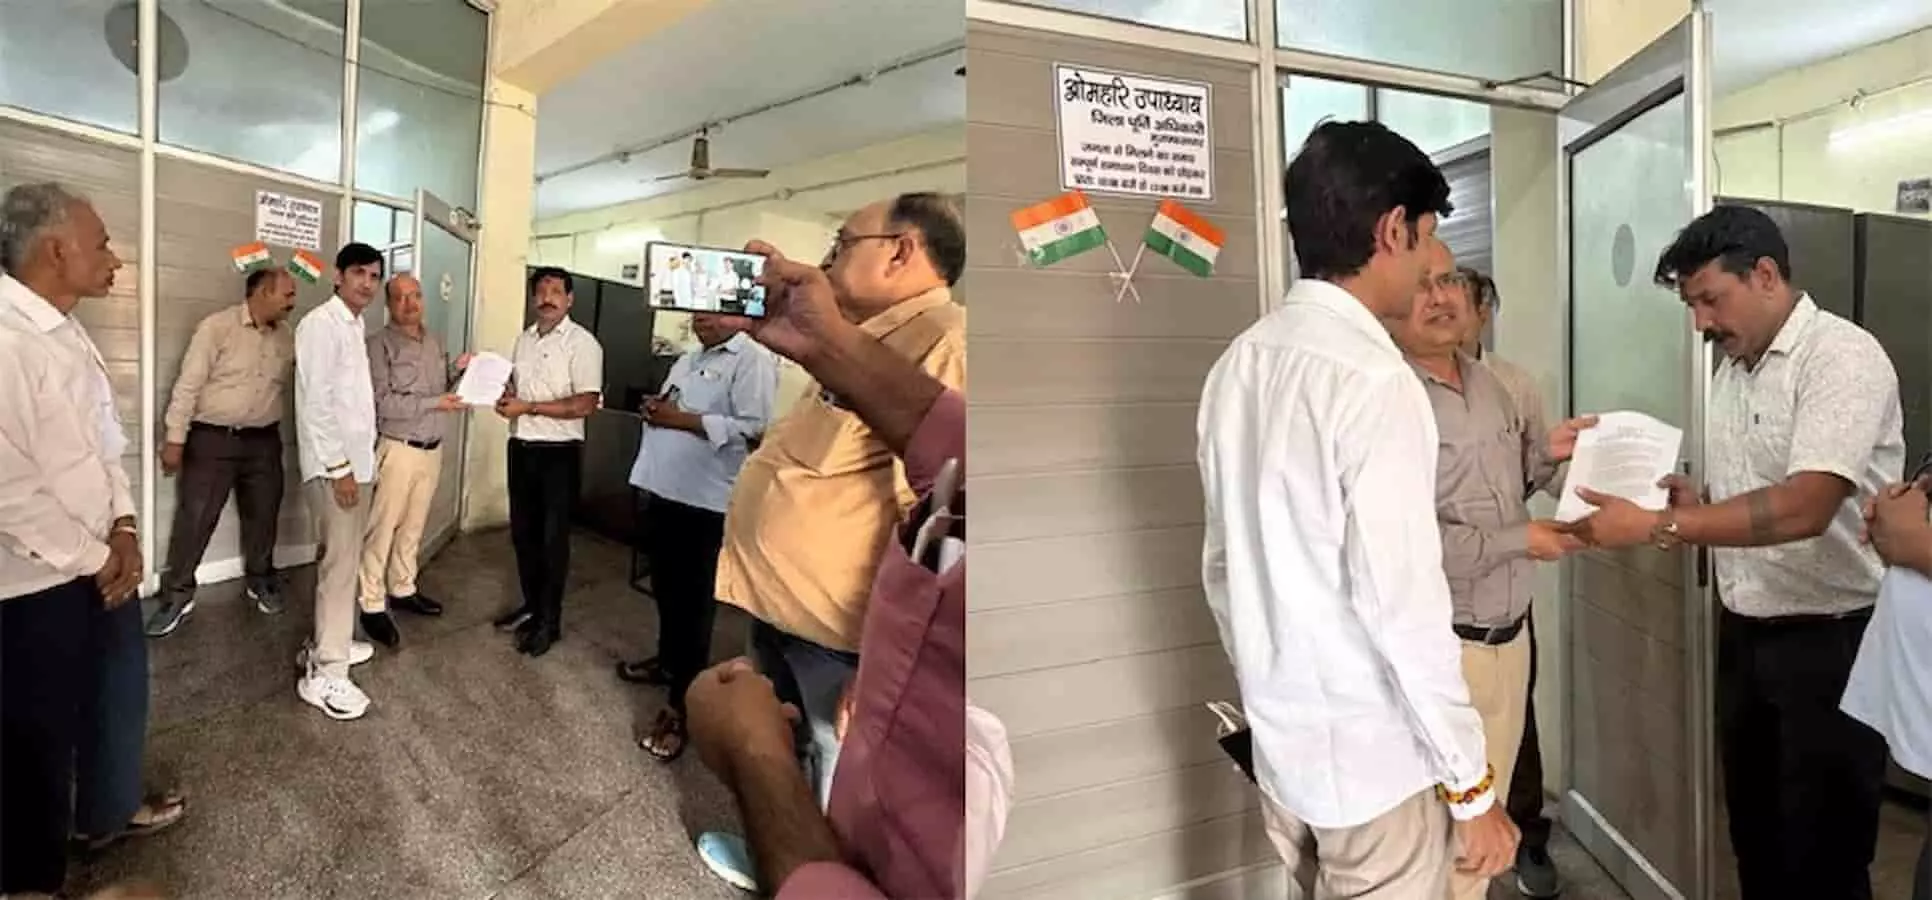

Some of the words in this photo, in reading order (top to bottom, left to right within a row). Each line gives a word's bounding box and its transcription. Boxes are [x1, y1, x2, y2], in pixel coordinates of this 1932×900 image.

[1064, 72, 1130, 109] ओमहरि
[1134, 88, 1203, 115] उपाध्याय
[1091, 108, 1125, 126] जिला
